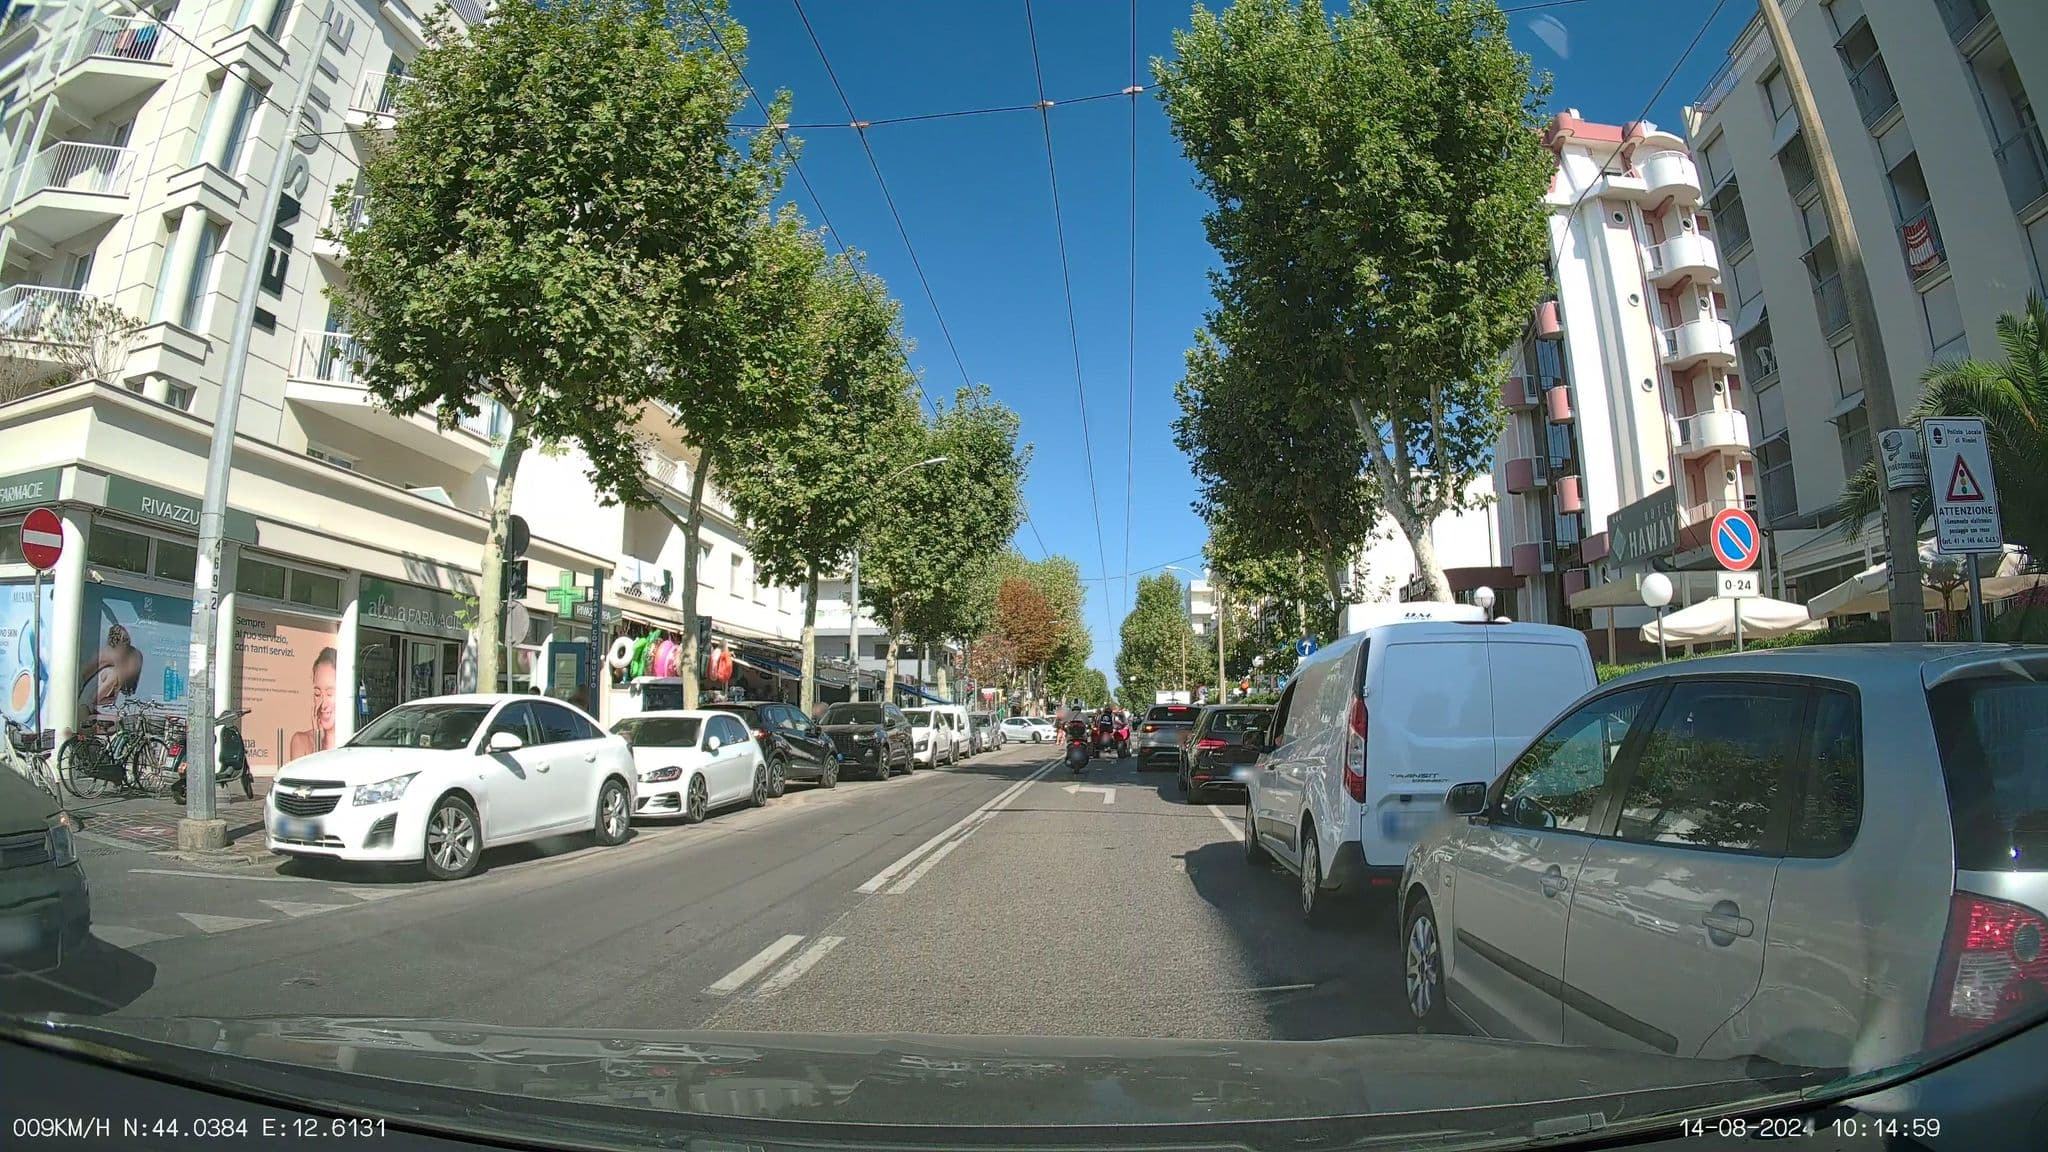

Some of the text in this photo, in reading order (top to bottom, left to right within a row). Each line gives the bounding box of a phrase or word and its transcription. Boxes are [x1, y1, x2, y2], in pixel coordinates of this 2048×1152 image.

[141, 496, 200, 525] RIVAZZU
[1629, 514, 1676, 559] HAWAY
[1725, 580, 1751, 590] 0-24
[236, 616, 266, 629] Sempre
[235, 630, 243, 638] al
[258, 634, 289, 645] servizio,
[235, 643, 295, 657] con tanti servizi.
[590, 629, 598, 688] CONTINUATO
